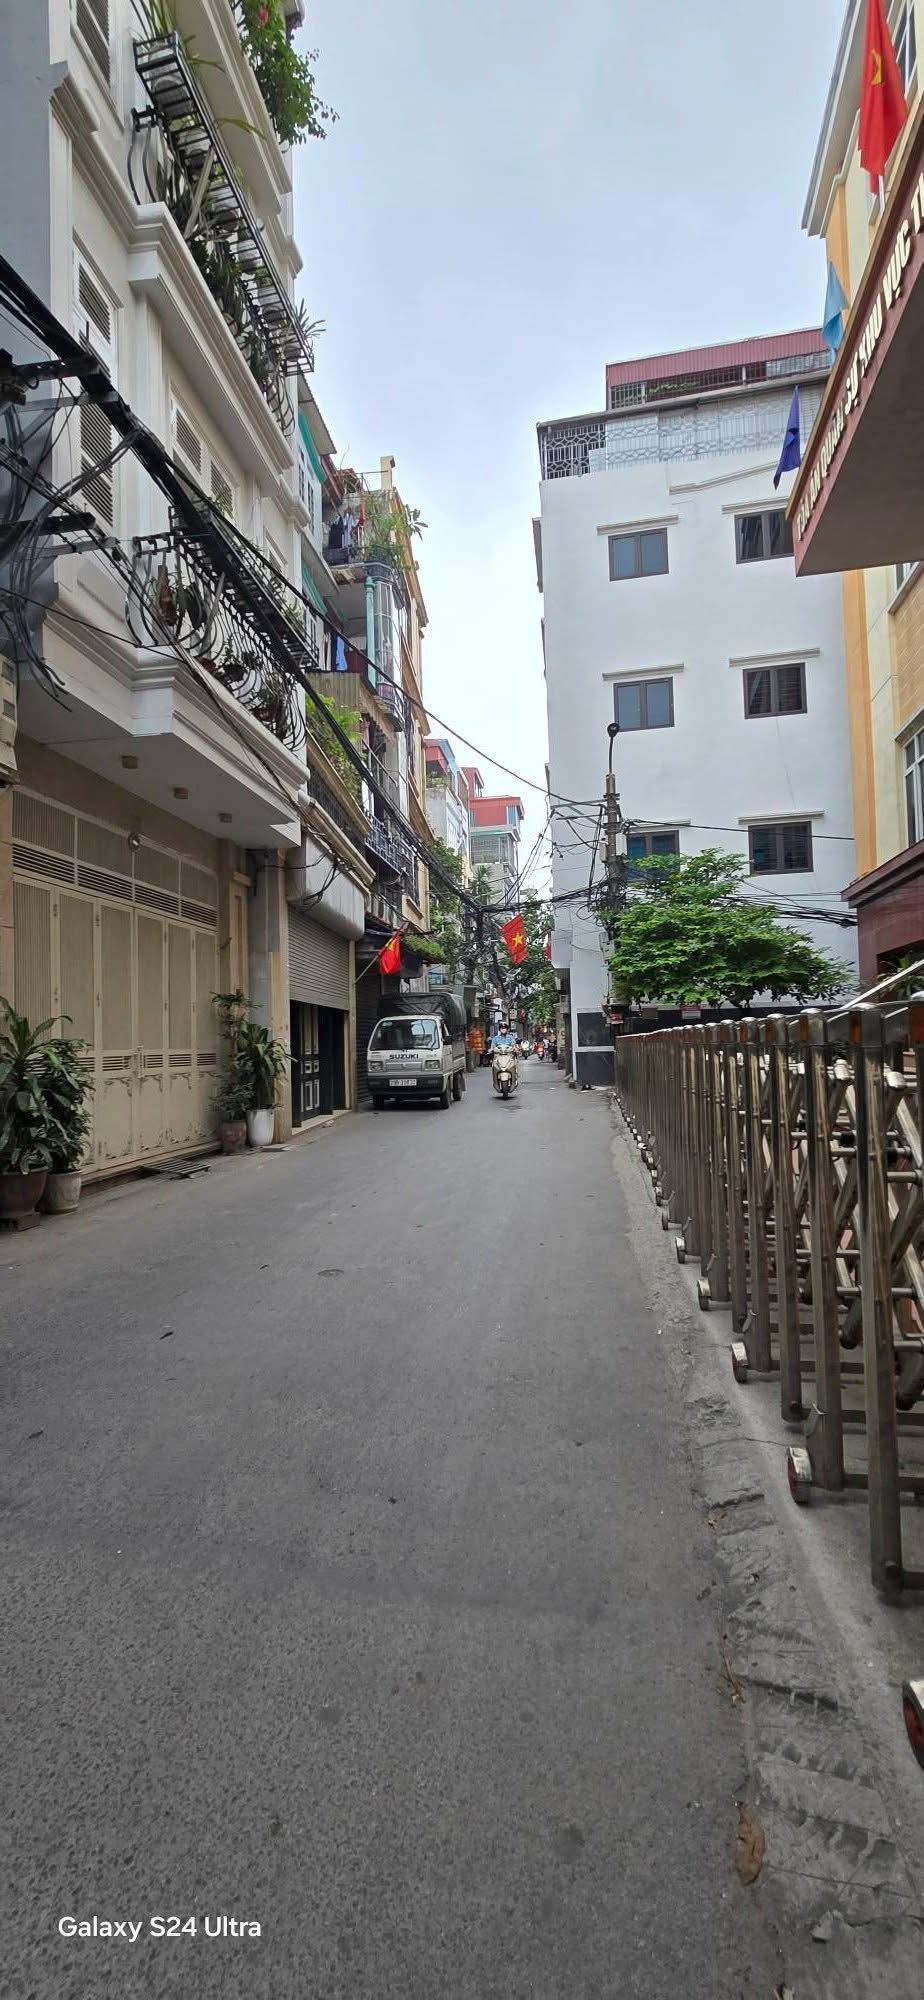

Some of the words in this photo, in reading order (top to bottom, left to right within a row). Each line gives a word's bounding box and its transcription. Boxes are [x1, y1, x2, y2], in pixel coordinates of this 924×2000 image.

[821, 401, 844, 478] QUÂN
[844, 352, 858, 415] SỰ
[859, 292, 883, 377] KHU
[882, 219, 911, 309] VỰC
